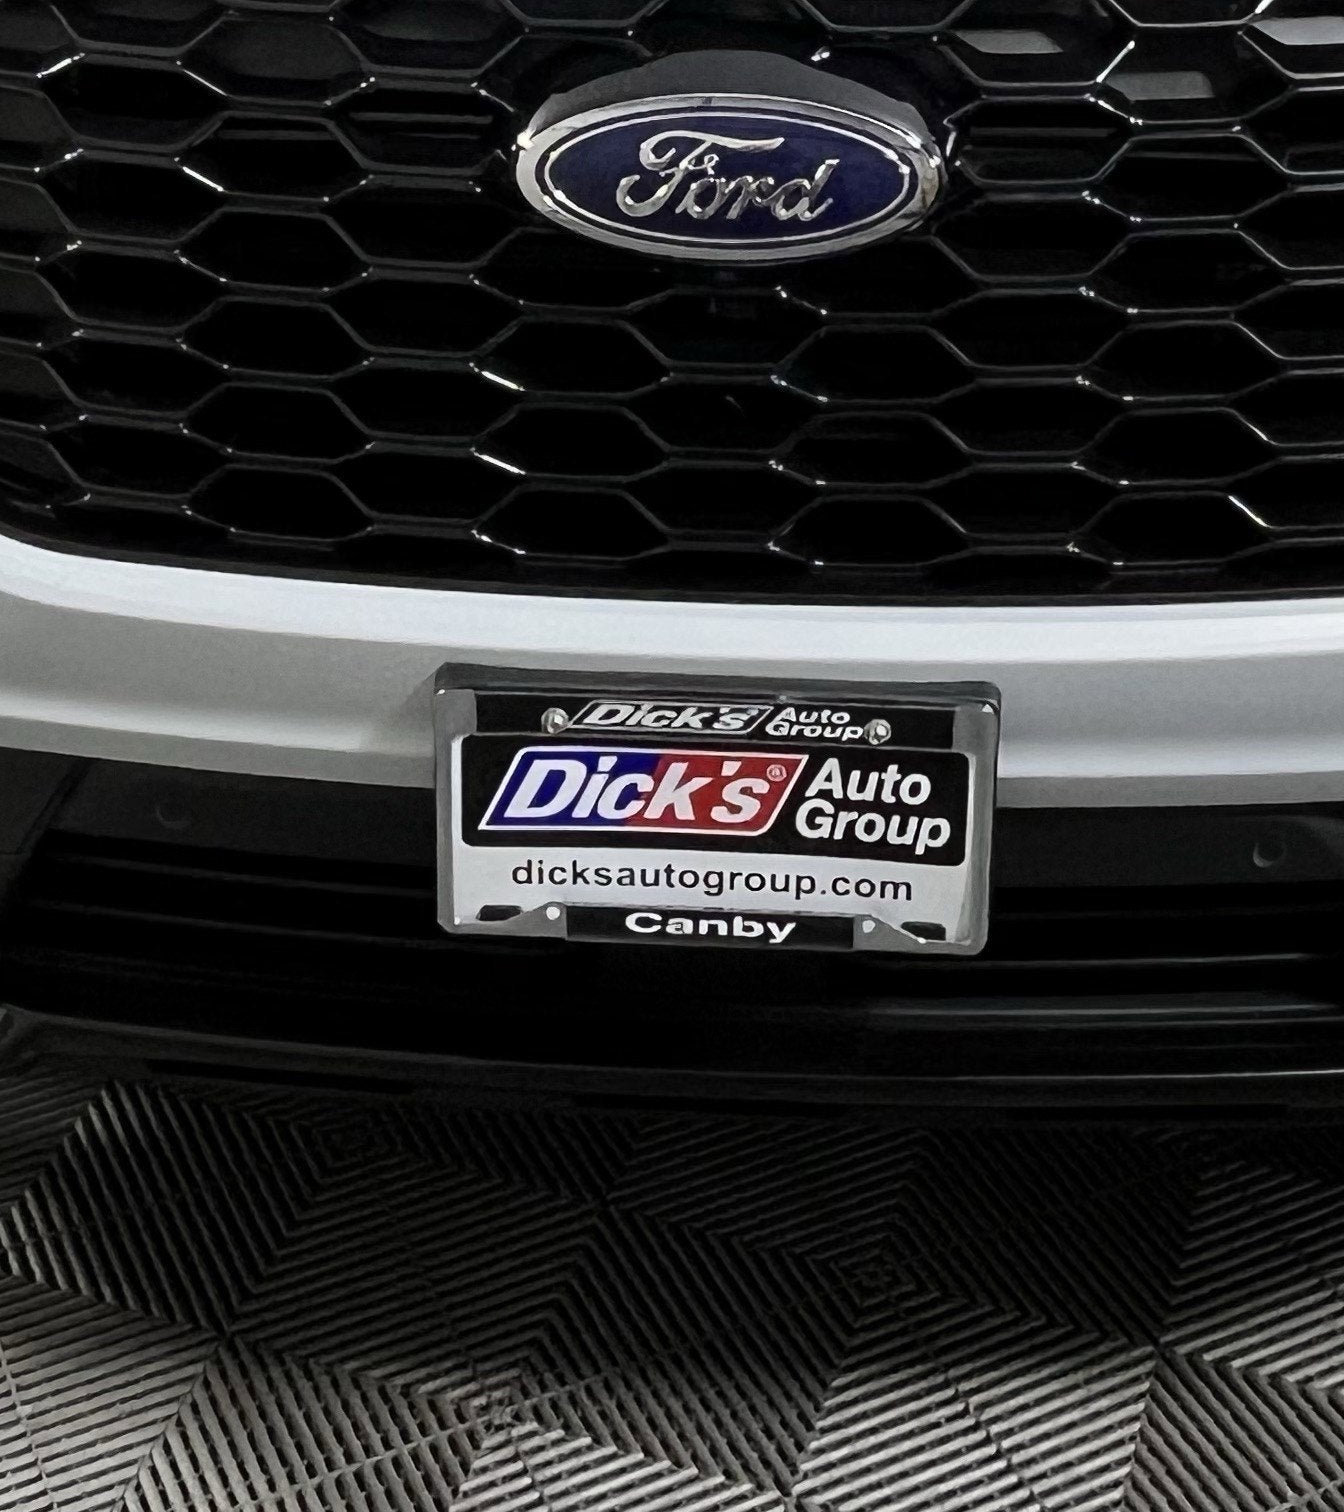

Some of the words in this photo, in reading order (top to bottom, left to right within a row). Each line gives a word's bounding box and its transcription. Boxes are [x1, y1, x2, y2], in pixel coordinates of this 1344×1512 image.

[616, 129, 839, 221] Ford
[765, 721, 865, 742] Group
[776, 706, 851, 726] Auto
[805, 757, 932, 806] Auto
[795, 804, 951, 855] Group
[511, 859, 913, 901] dicksautogroup.com
[625, 912, 797, 944] Canby
